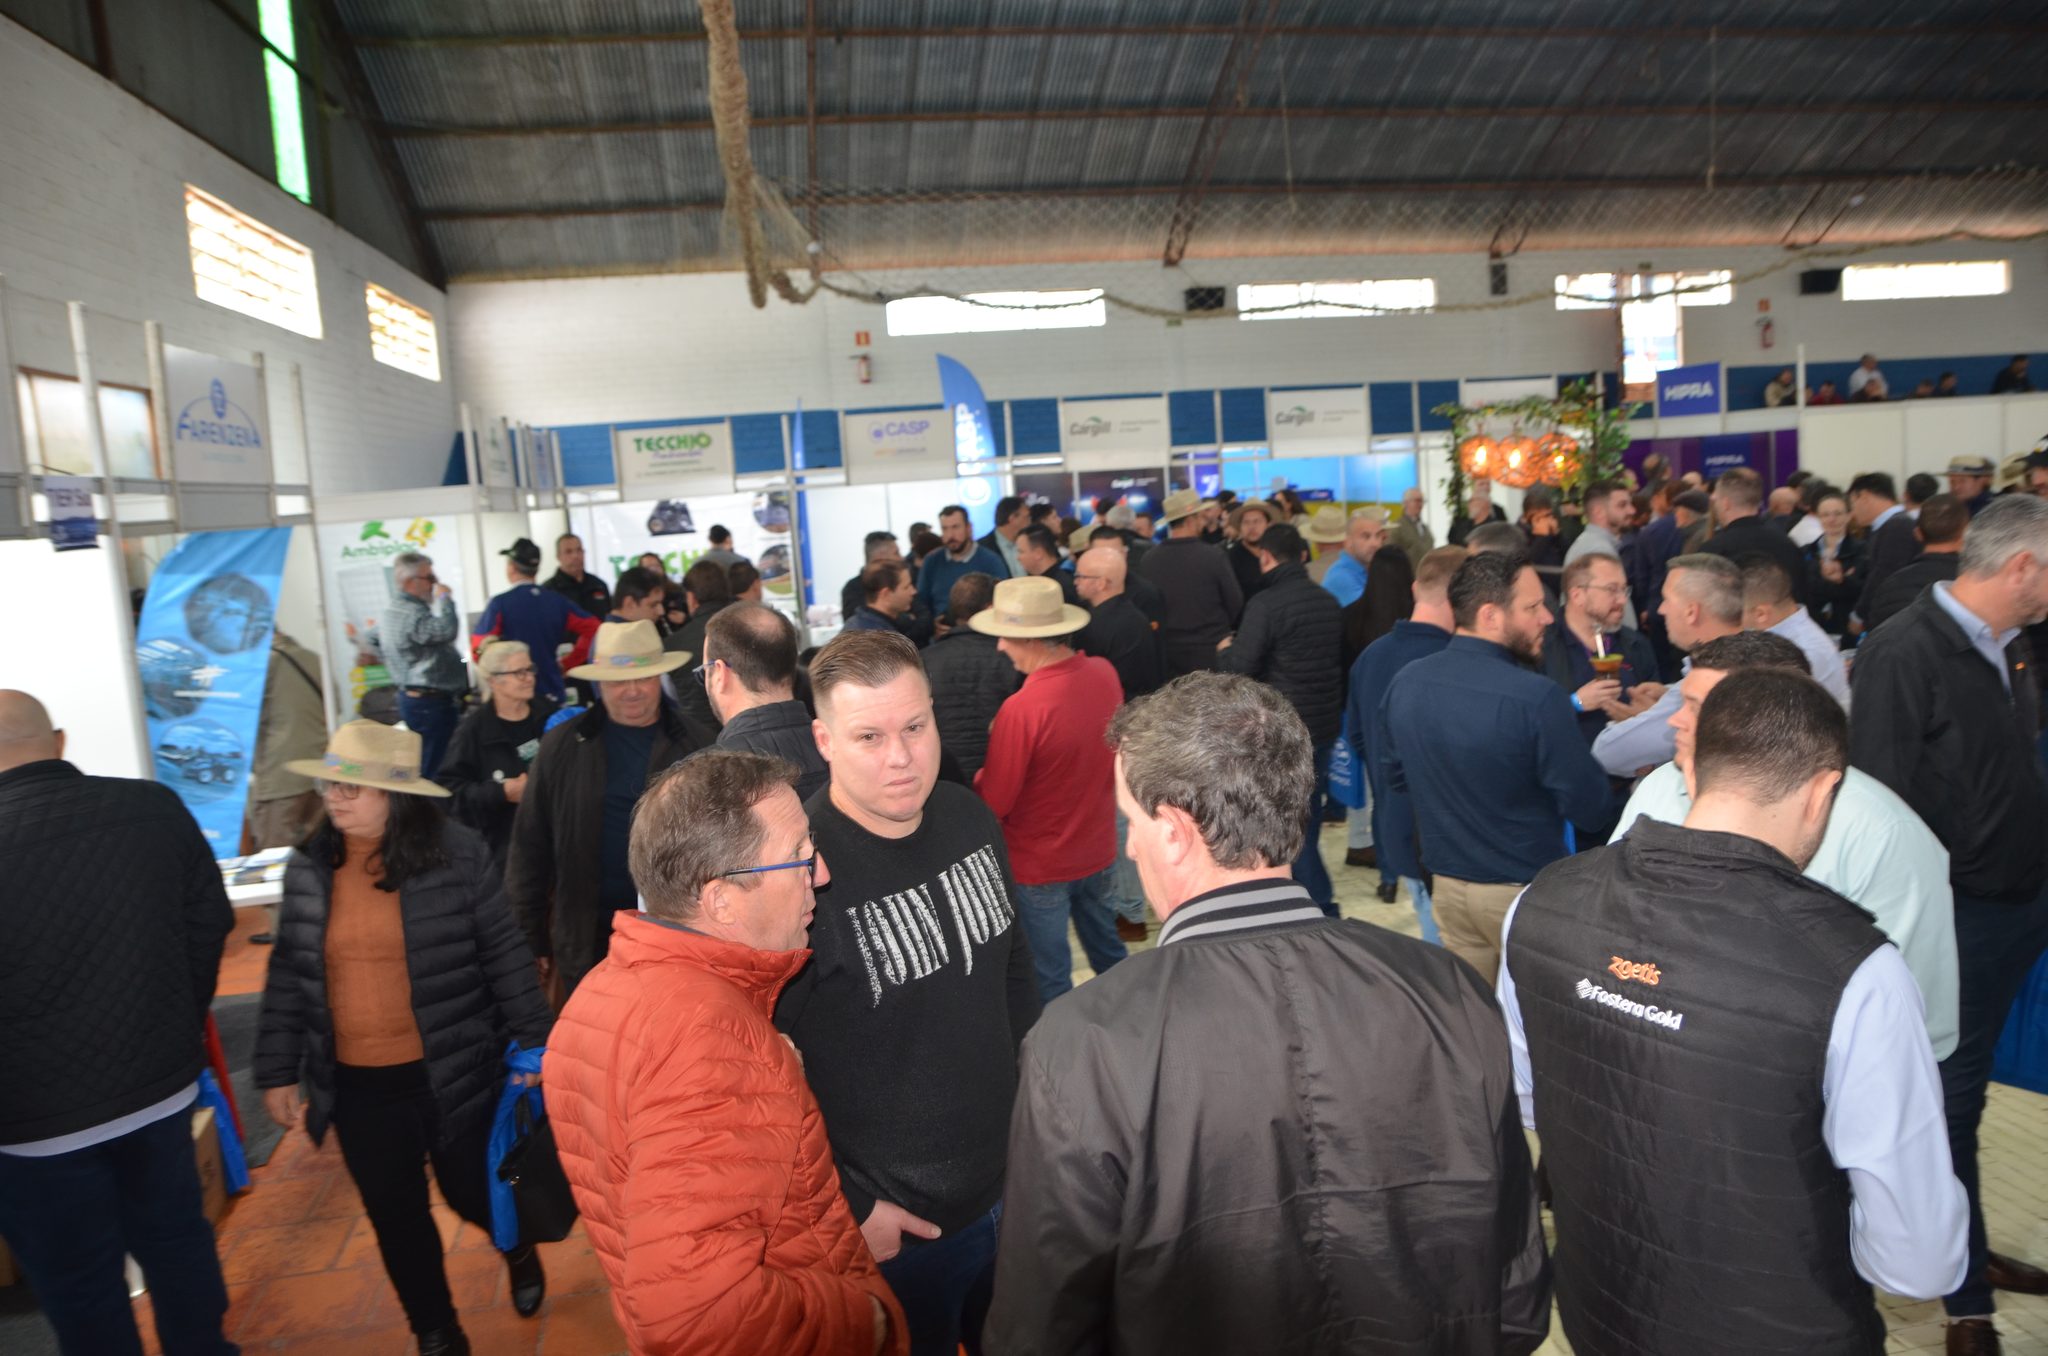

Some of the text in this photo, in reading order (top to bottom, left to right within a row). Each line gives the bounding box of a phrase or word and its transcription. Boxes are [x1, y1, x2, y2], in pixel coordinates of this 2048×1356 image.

[1664, 381, 1714, 401] HIPRA
[1275, 408, 1315, 427] Cargill
[885, 420, 931, 437] CASP
[1070, 420, 1112, 437] Cargill
[633, 432, 713, 453] TECCHIO
[846, 844, 1016, 1008] JOHN JOHN
[1608, 955, 1662, 986] zoetis
[1589, 985, 1684, 1031] Fostera Gold
